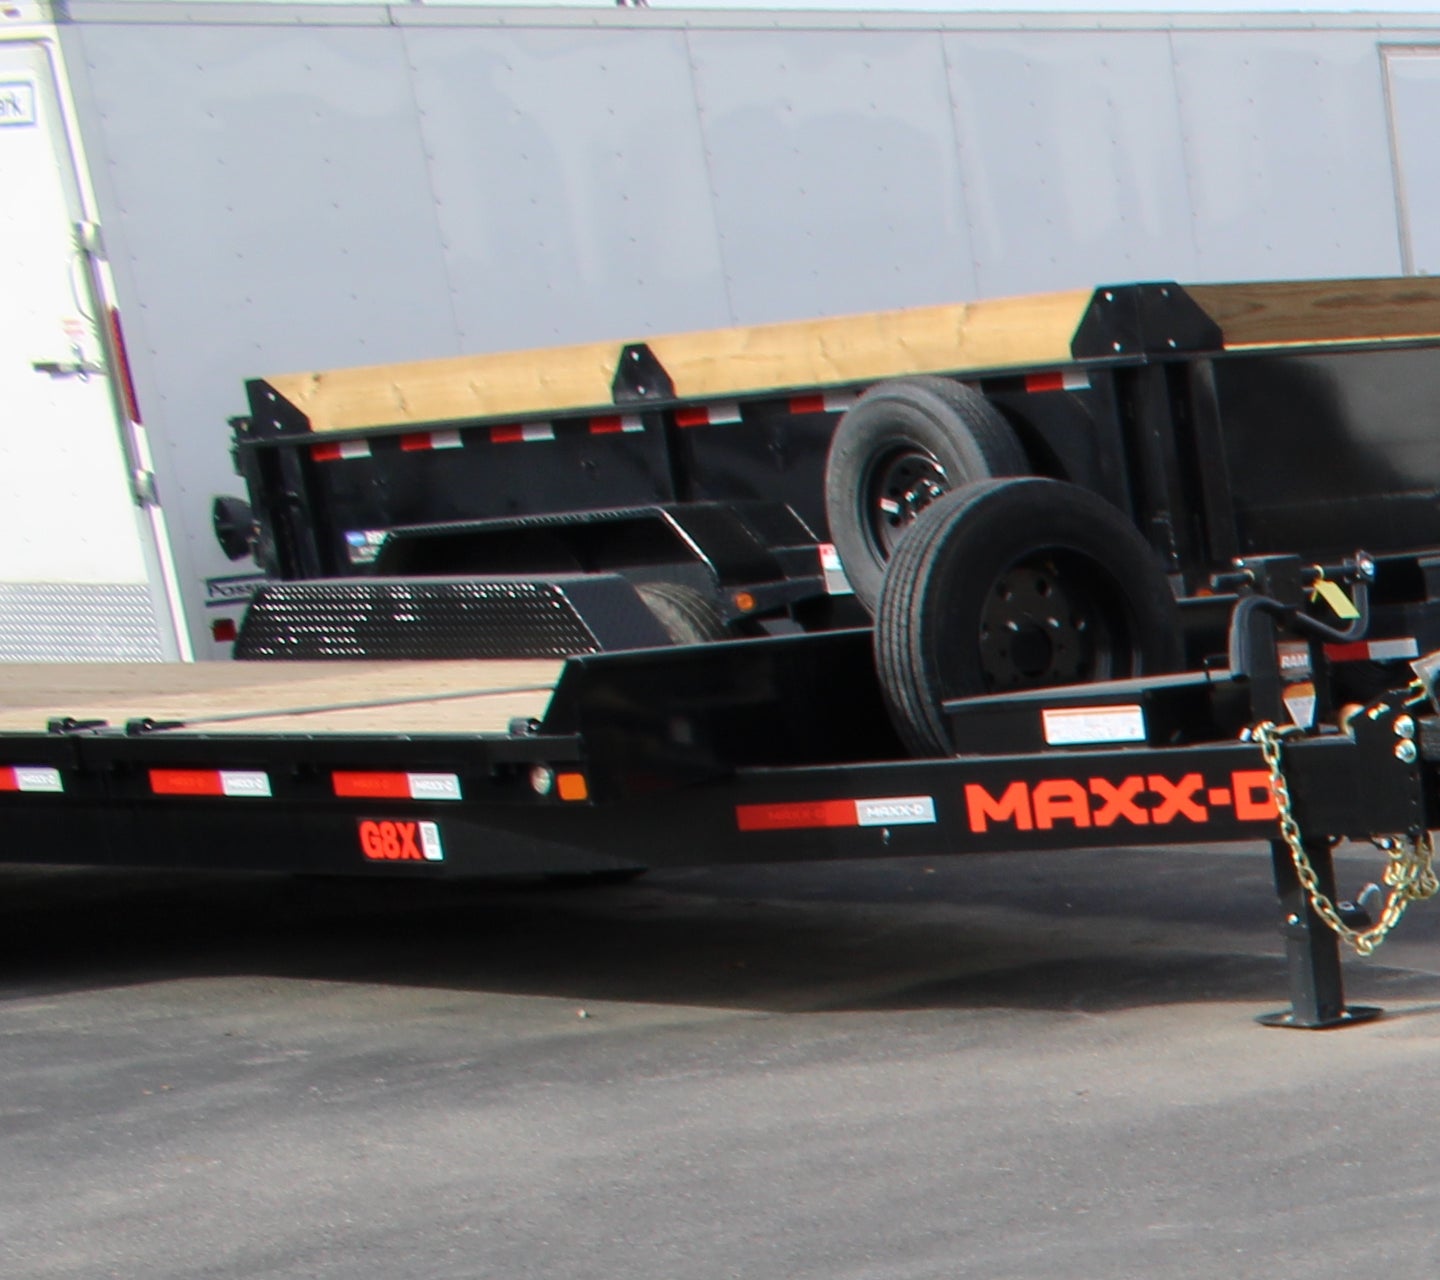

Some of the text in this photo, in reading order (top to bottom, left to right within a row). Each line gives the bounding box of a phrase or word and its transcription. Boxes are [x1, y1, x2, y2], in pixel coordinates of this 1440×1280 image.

[1281, 653, 1309, 669] RAM
[866, 803, 924, 818] MAXX-D
[965, 771, 1284, 833] MAXX-D
[360, 820, 421, 860] G8X
